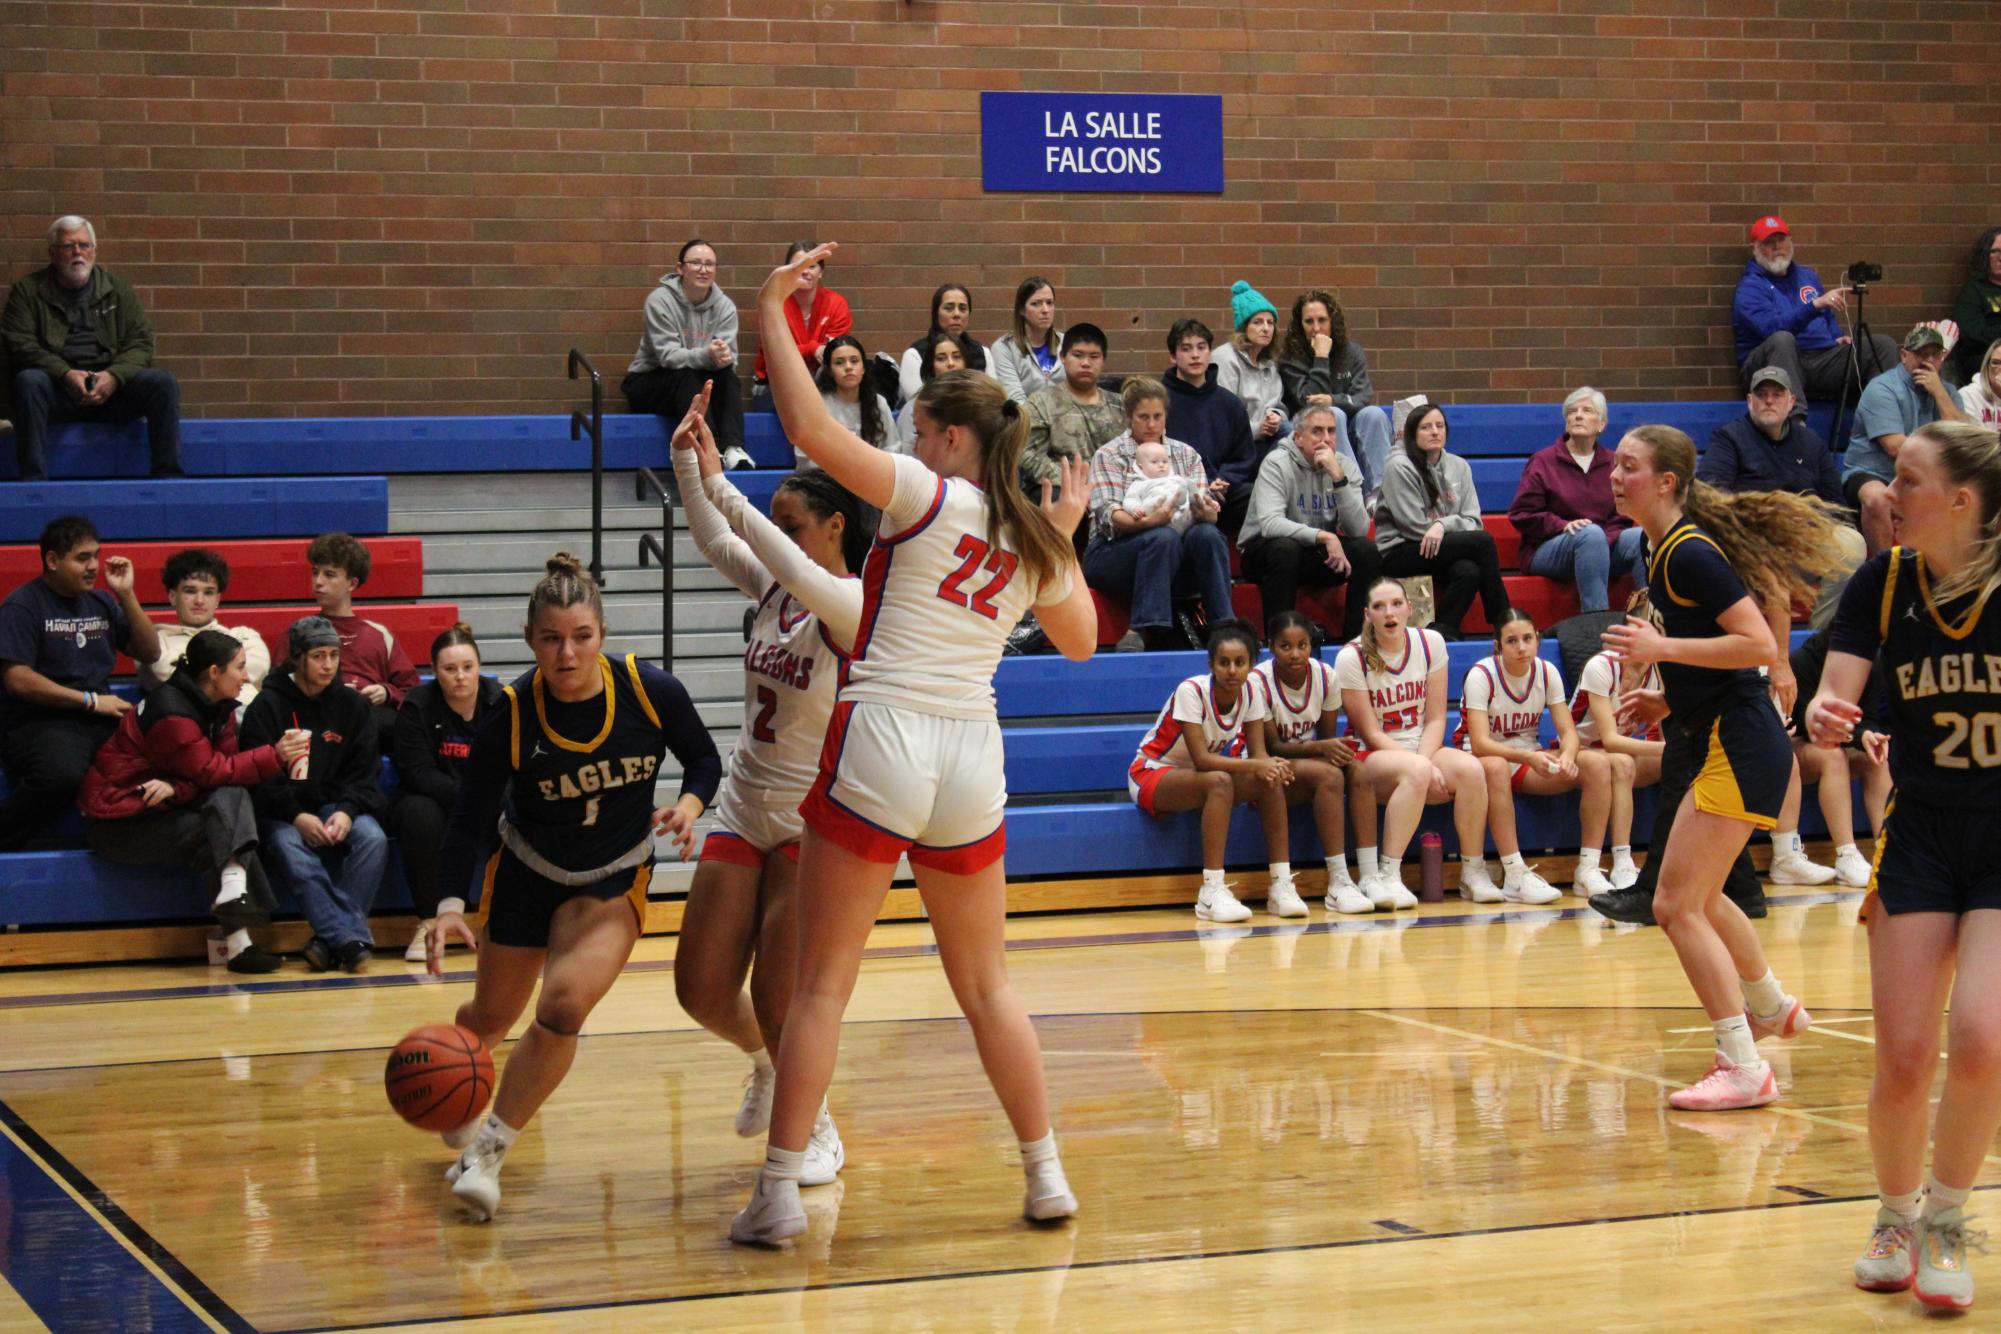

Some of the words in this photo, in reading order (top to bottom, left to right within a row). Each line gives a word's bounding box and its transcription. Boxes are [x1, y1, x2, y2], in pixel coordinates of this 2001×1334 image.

[1045, 111, 1079, 138] LA
[1085, 111, 1162, 139] SALLE
[1046, 146, 1162, 174] FALCONS
[936, 533, 1019, 621] 22
[752, 684, 778, 744] 2
[1932, 711, 2001, 769] 20
[538, 755, 657, 801] EAGLES
